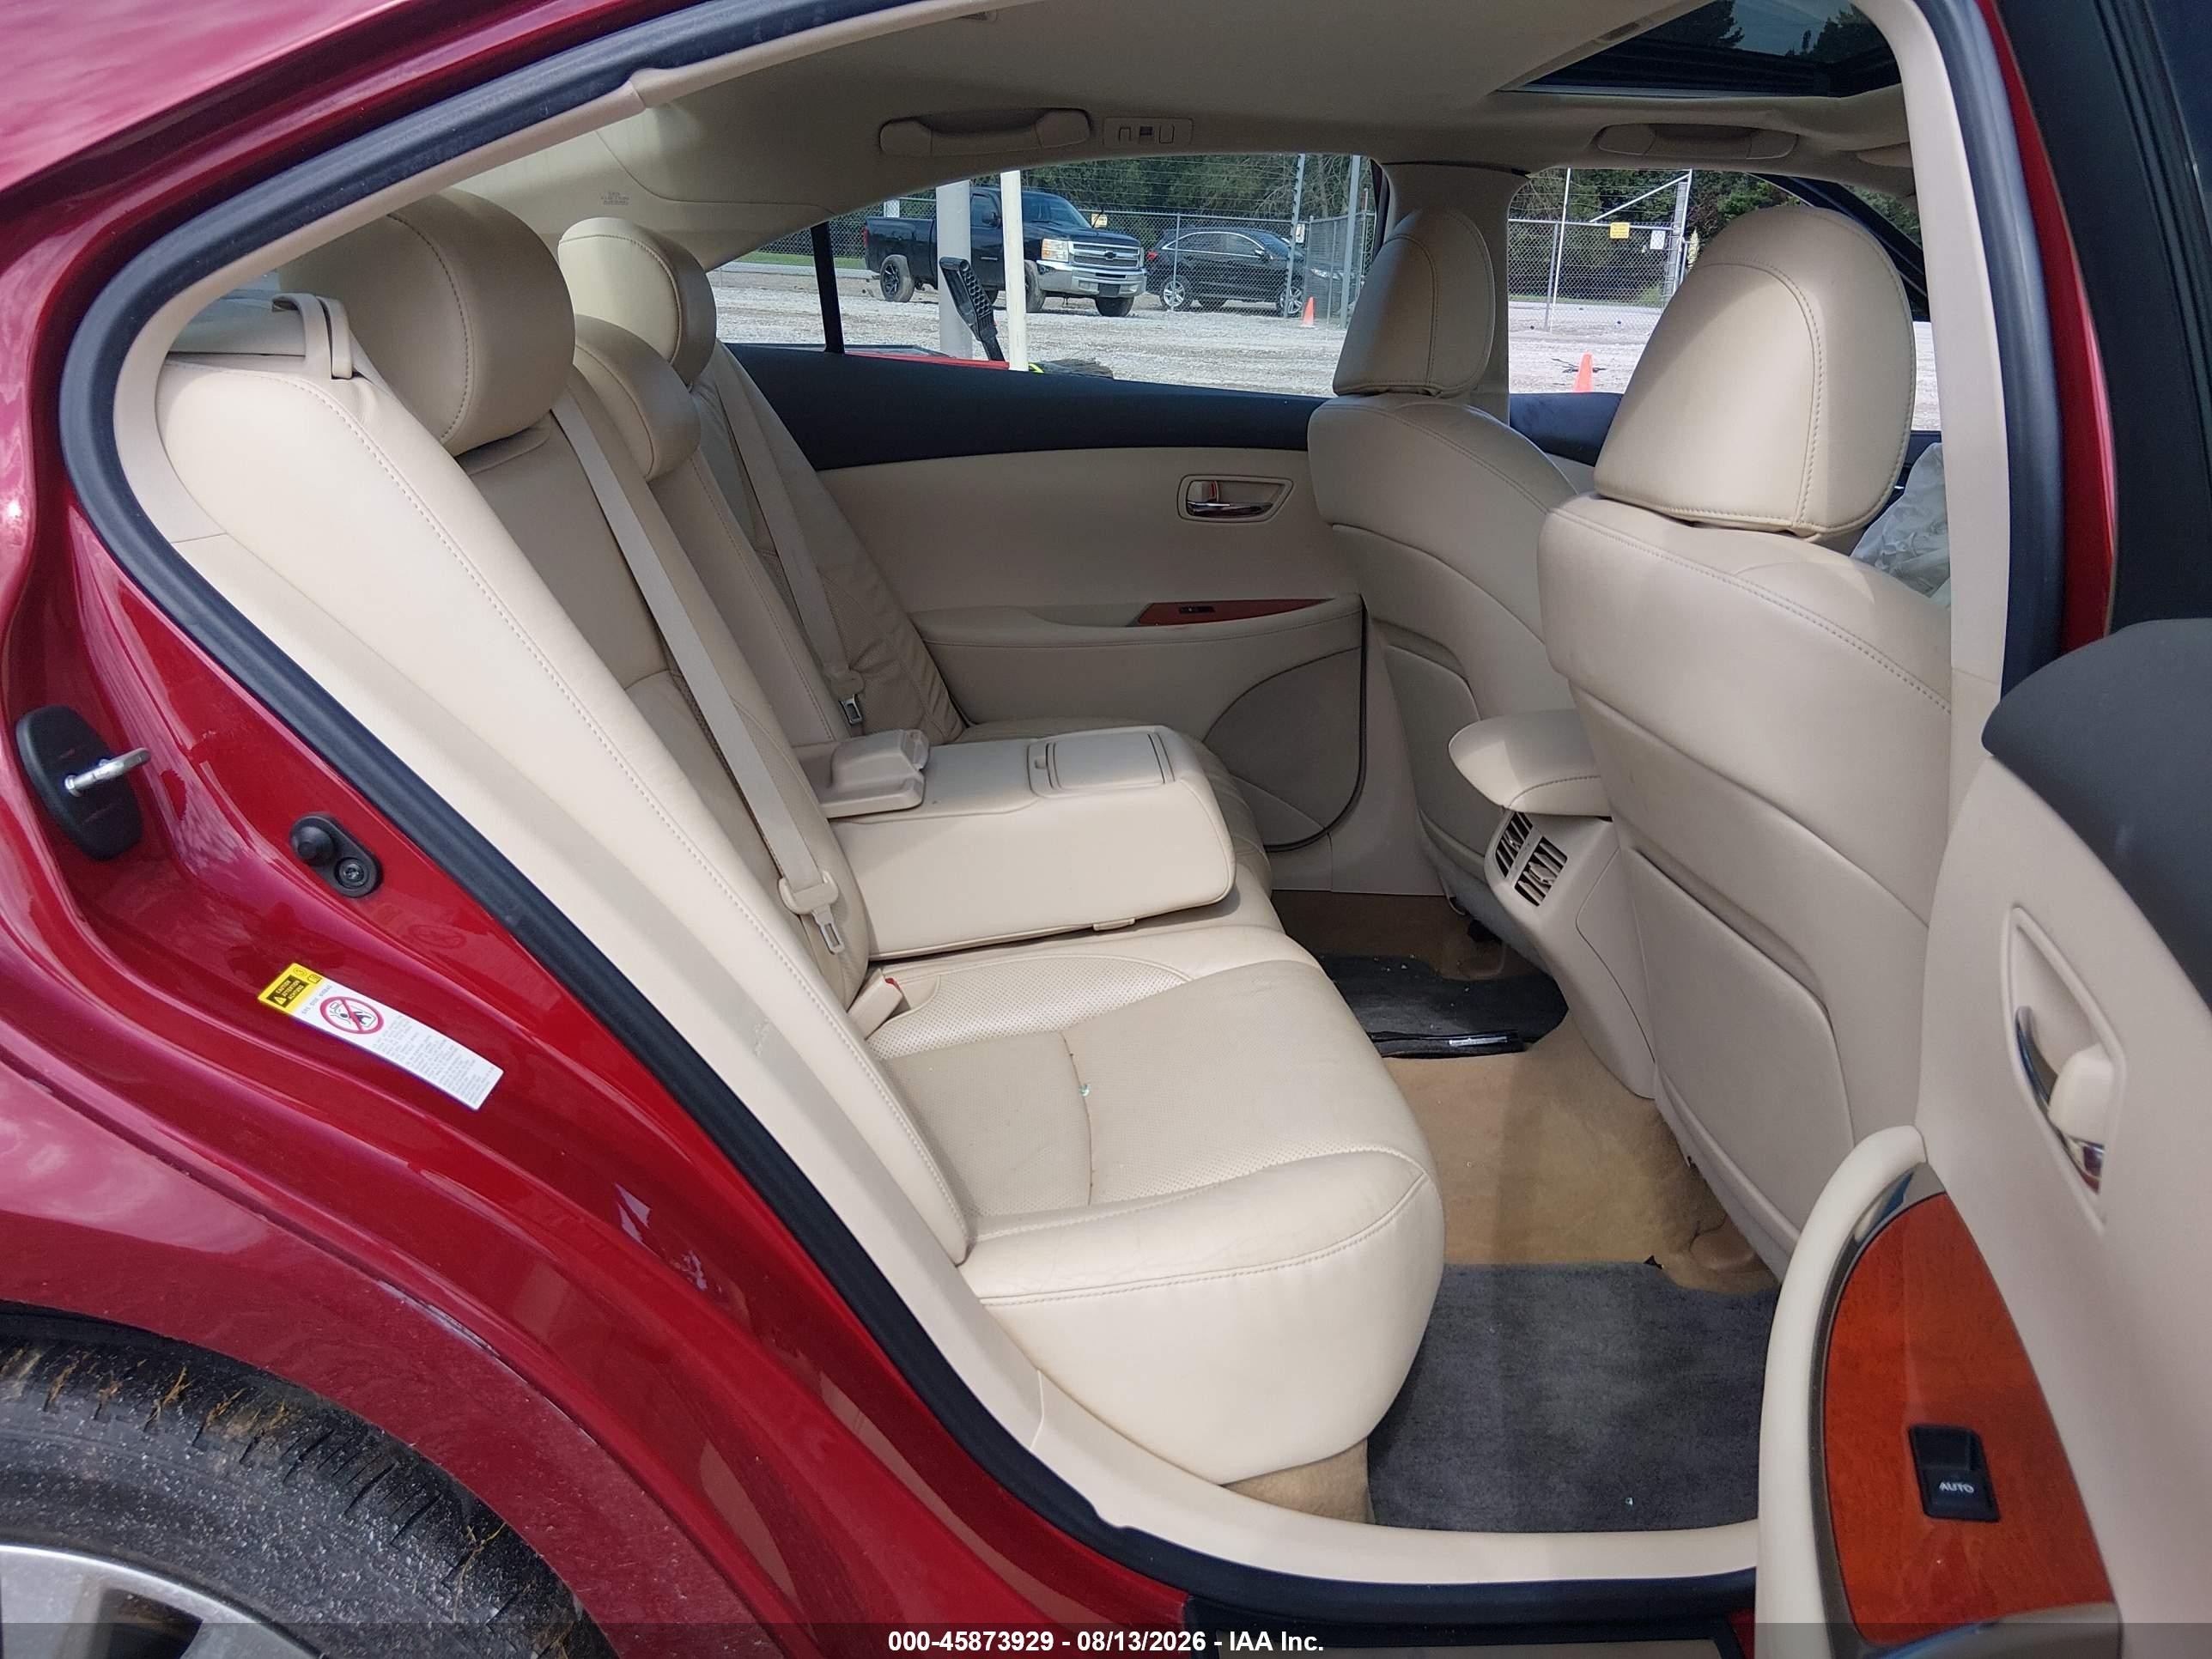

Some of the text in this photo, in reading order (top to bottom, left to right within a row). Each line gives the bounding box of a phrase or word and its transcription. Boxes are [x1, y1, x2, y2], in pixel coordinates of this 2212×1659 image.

[276, 980, 292, 994] CAUTION
[282, 980, 301, 997] ATTENTION
[288, 984, 304, 1000] ACHTUNG
[1939, 1481, 1974, 1493] AUTO
